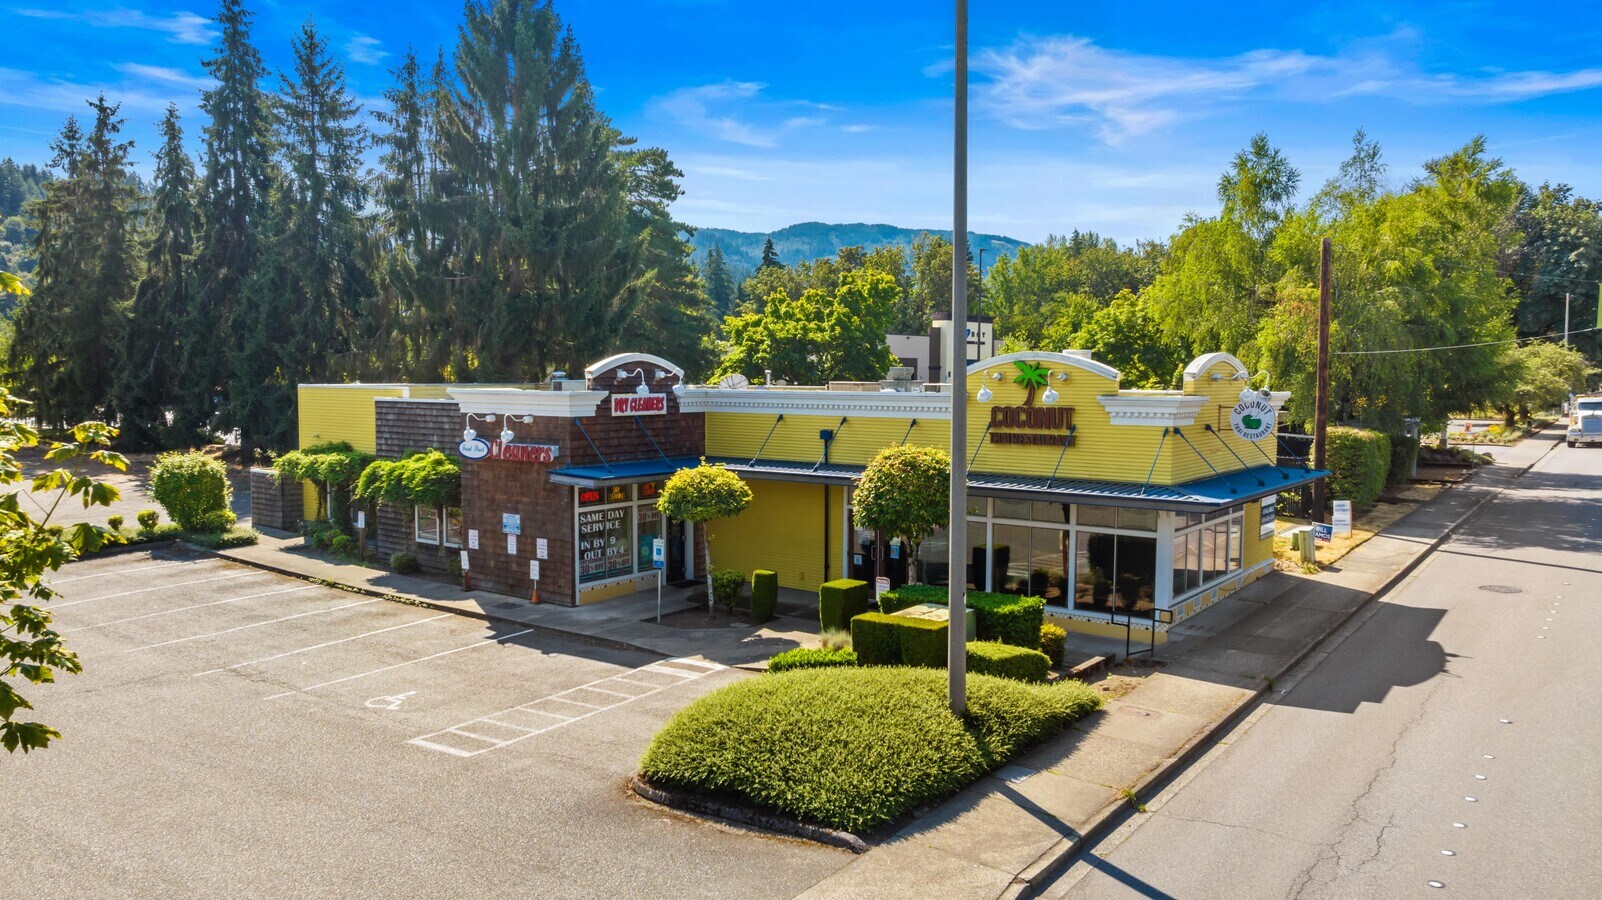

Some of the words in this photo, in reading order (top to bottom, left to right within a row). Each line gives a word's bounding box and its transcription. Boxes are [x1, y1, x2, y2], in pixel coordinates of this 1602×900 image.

[614, 397, 629, 413] DRY
[630, 396, 665, 412] CLEANERS
[991, 405, 1075, 430] COCONUT
[1233, 422, 1244, 435] THAI
[1242, 422, 1272, 440] RESTAURANT
[989, 432, 1011, 445] THAI
[1011, 433, 1077, 447] RESTAURANT
[490, 439, 552, 463] Cleaners
[580, 491, 600, 501] OPEN
[580, 512, 605, 523] SAME
[608, 510, 625, 519] DAY
[581, 520, 620, 533] SERVICE
[581, 541, 591, 550] IN
[593, 538, 605, 548] BY
[610, 536, 616, 545] 9
[584, 549, 603, 560] OUT
[607, 547, 619, 556] BY
[618, 545, 625, 554] 4
[594, 562, 604, 570] OFF
[621, 557, 631, 566] OFF
